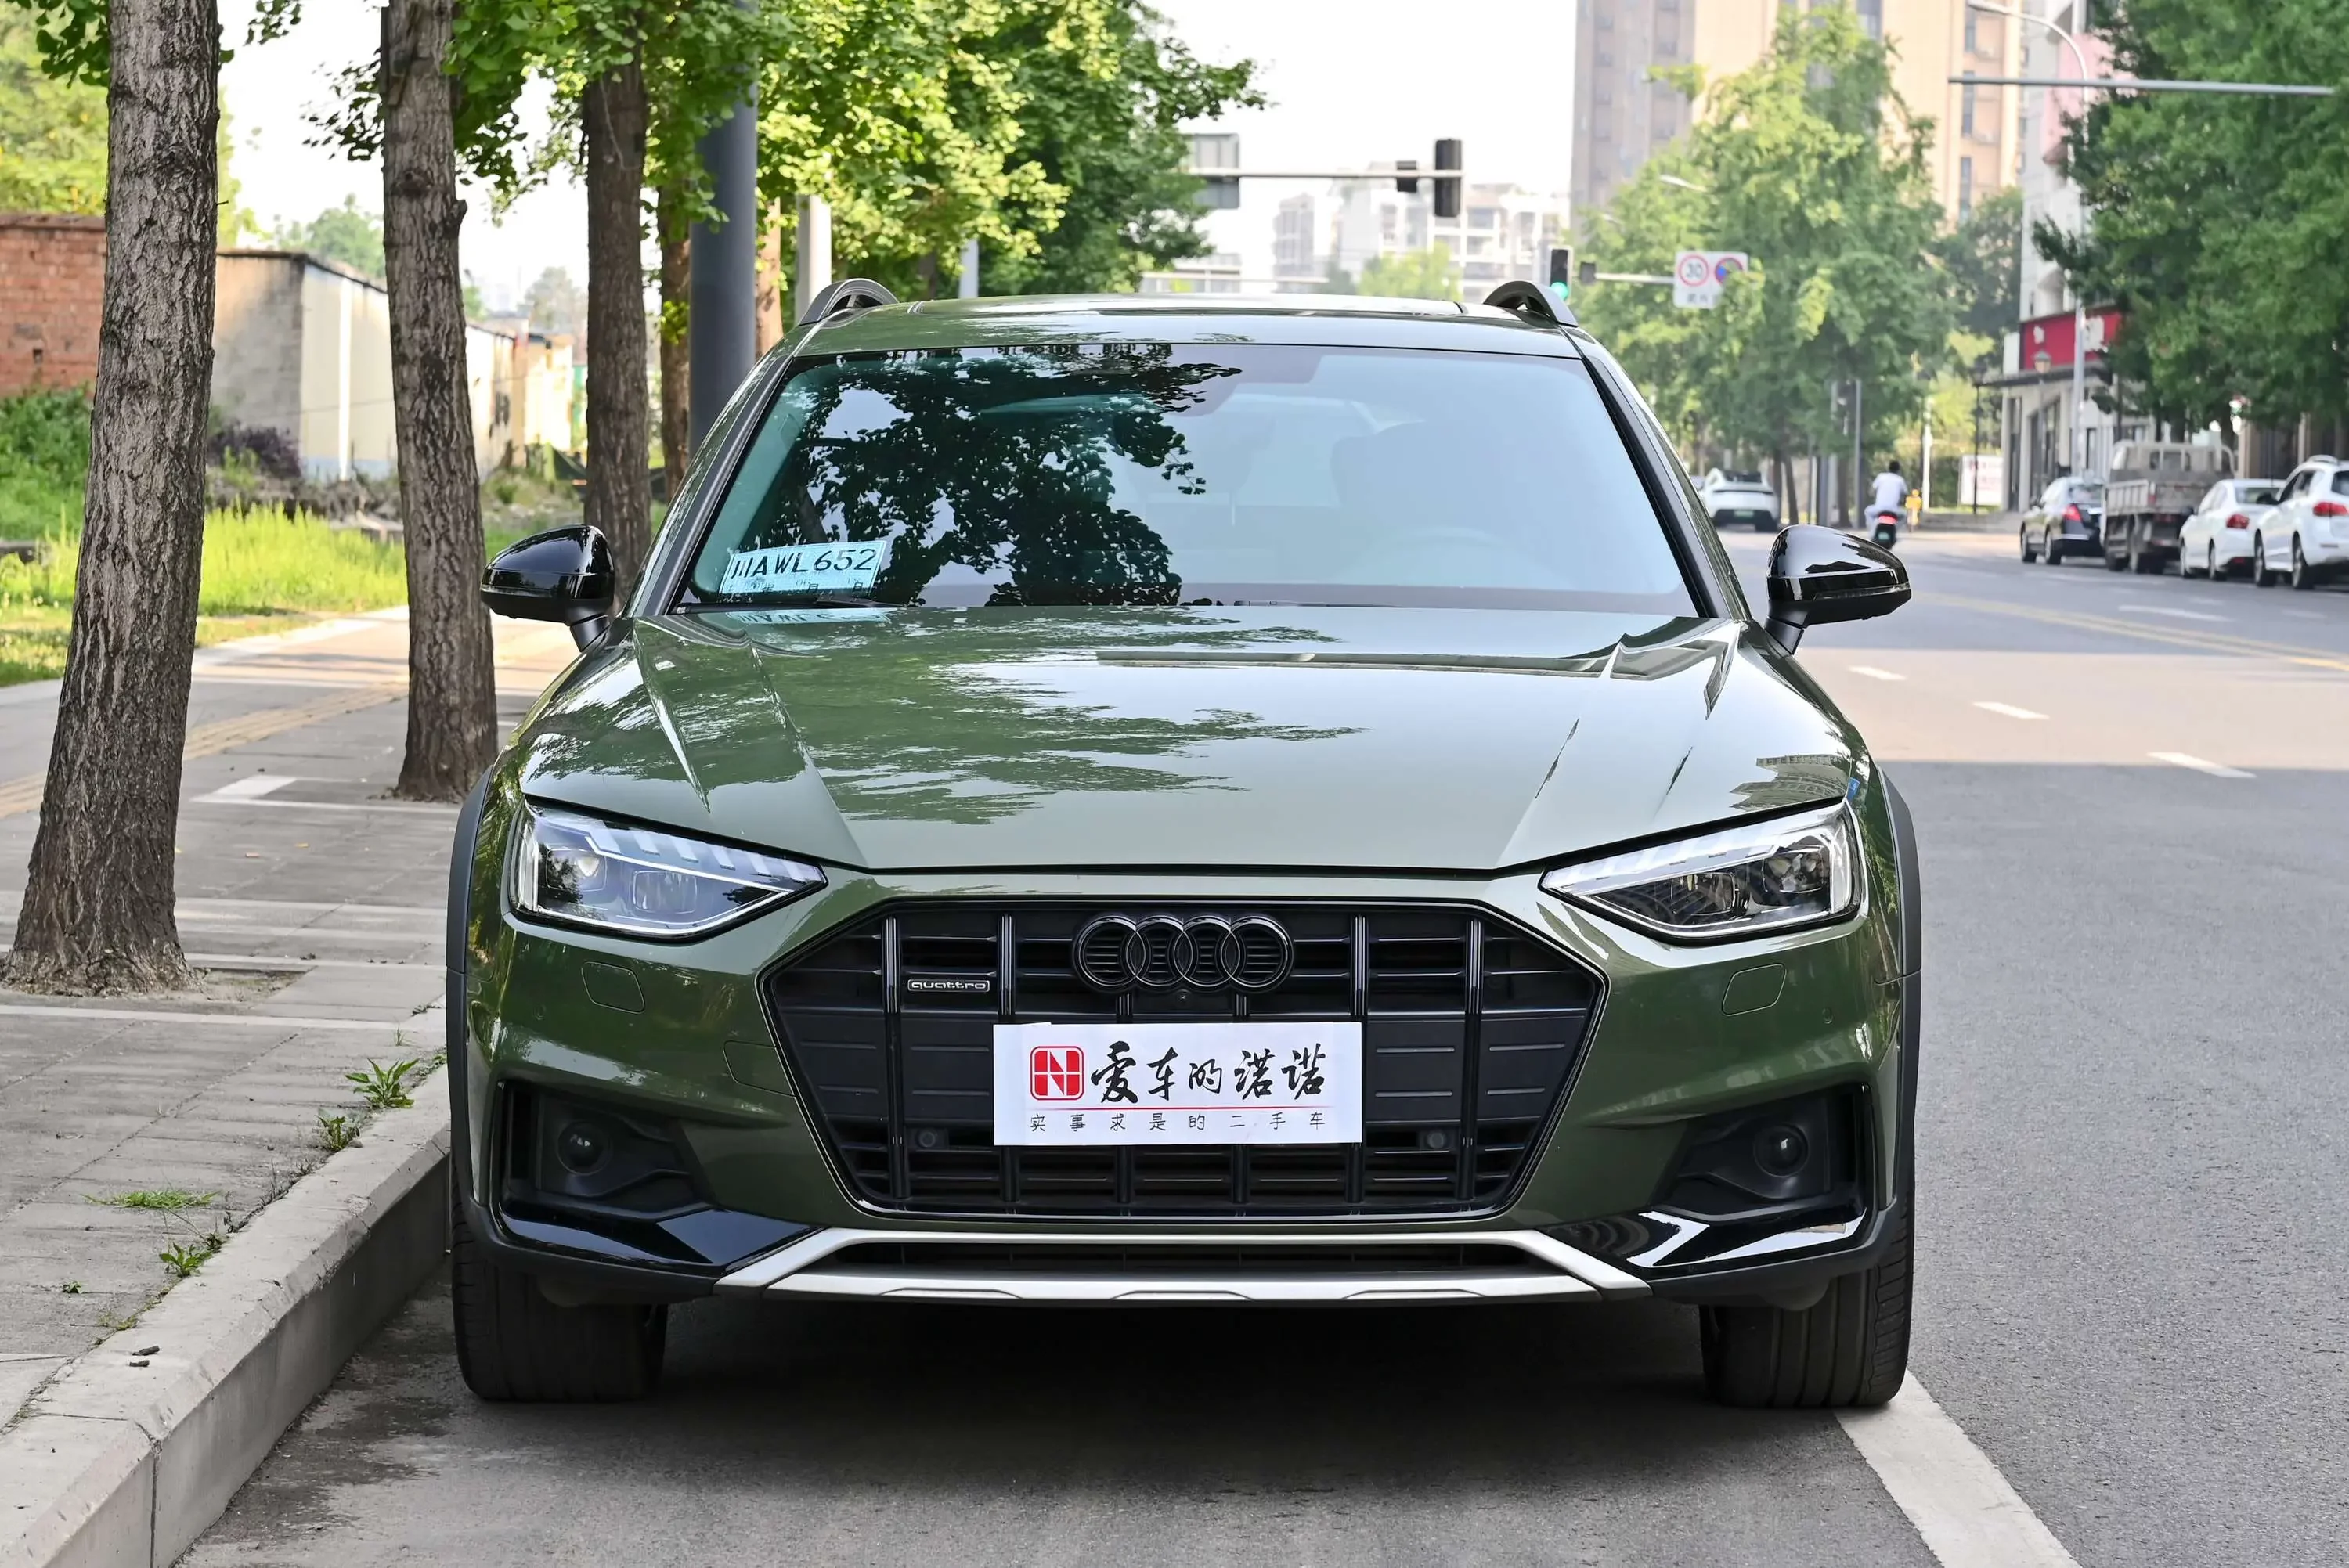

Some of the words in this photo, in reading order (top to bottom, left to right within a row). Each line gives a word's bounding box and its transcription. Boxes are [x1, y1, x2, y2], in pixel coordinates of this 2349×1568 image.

[731, 548, 877, 579] 川AWL652
[911, 981, 987, 990] quattro
[1091, 1040, 1326, 1104] 爱车的诺诺
[1030, 1112, 1326, 1132] 实事求是的二手车
